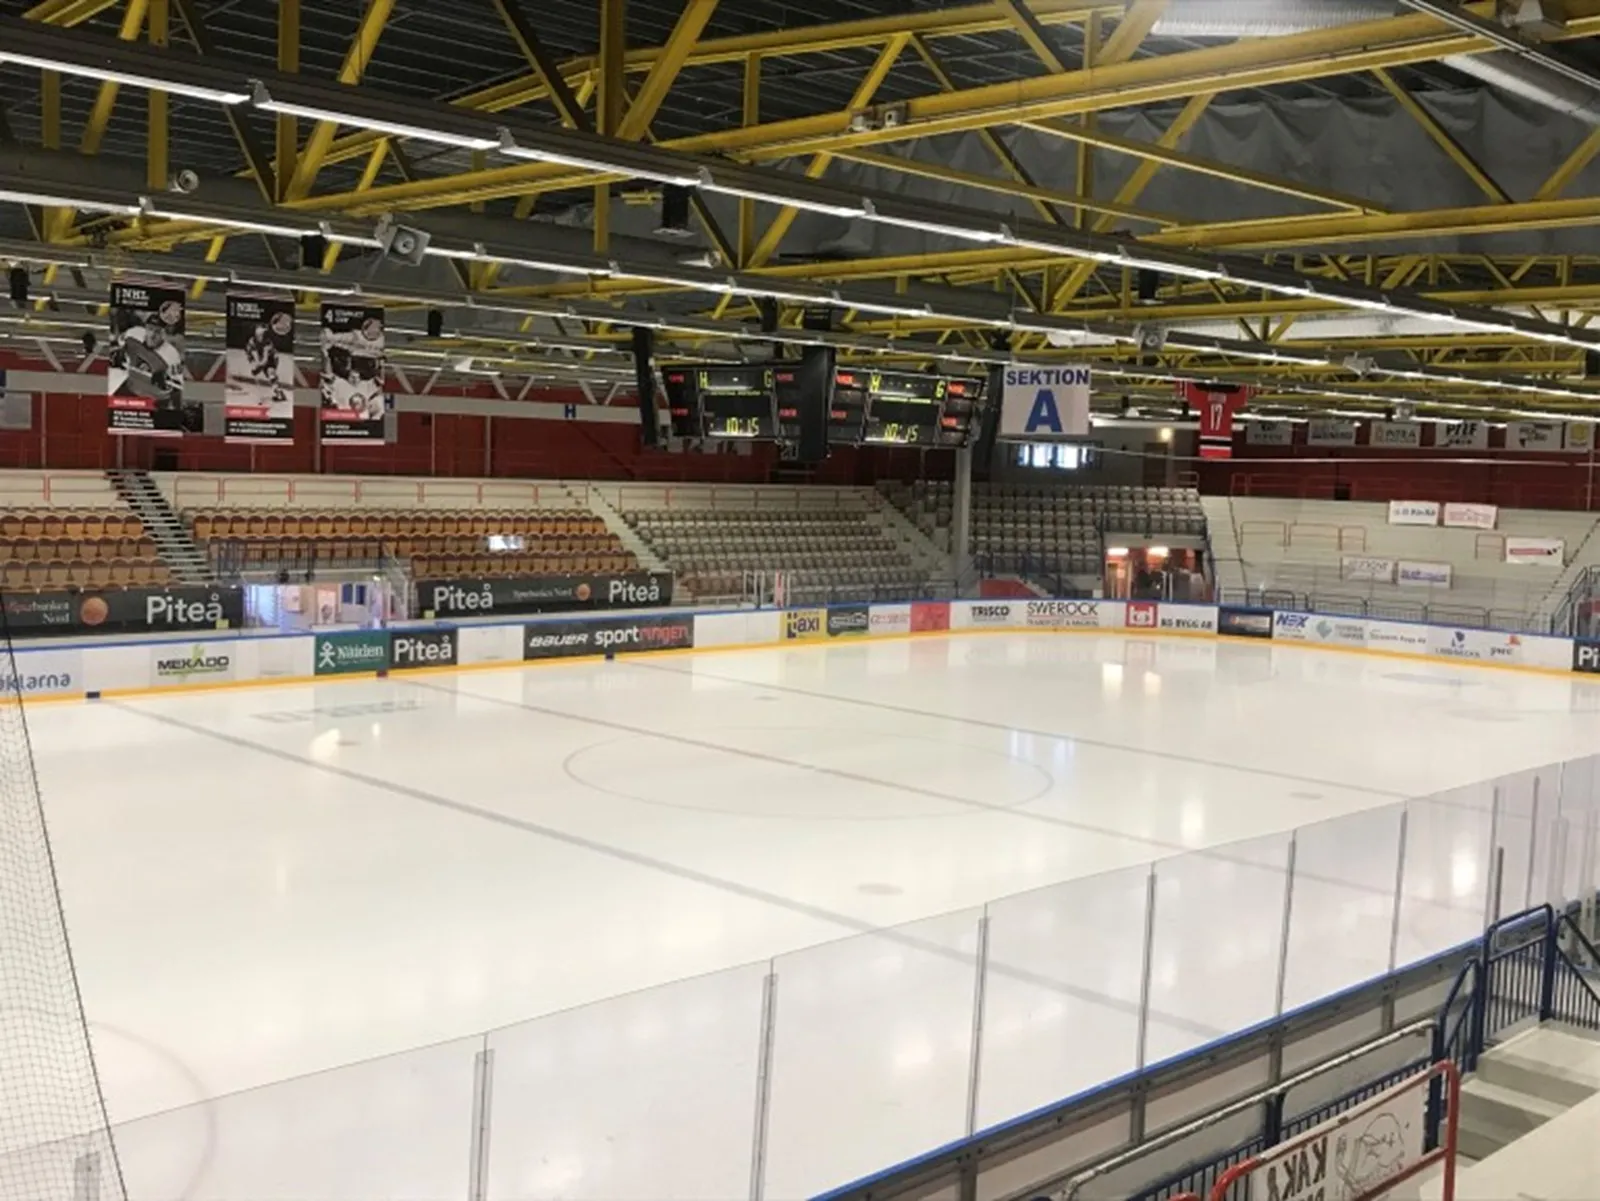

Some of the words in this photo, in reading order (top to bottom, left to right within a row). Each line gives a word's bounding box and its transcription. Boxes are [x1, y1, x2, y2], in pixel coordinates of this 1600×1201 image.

[1006, 369, 1089, 385] SEKTION
[564, 404, 576, 418] H
[1024, 388, 1063, 432] A
[1210, 403, 1223, 430] 17
[726, 417, 759, 434] 10:15
[884, 423, 919, 442] 10:15
[434, 583, 493, 611] Piteå
[609, 577, 659, 602] Piteå
[146, 592, 223, 624] Piteå
[971, 606, 1010, 617] TRISCO
[1027, 602, 1098, 615] SWEROCK
[529, 633, 588, 647] BAUER
[594, 624, 688, 647] sportringen
[394, 634, 452, 662] Piteå
[158, 655, 229, 669] MEKADO
